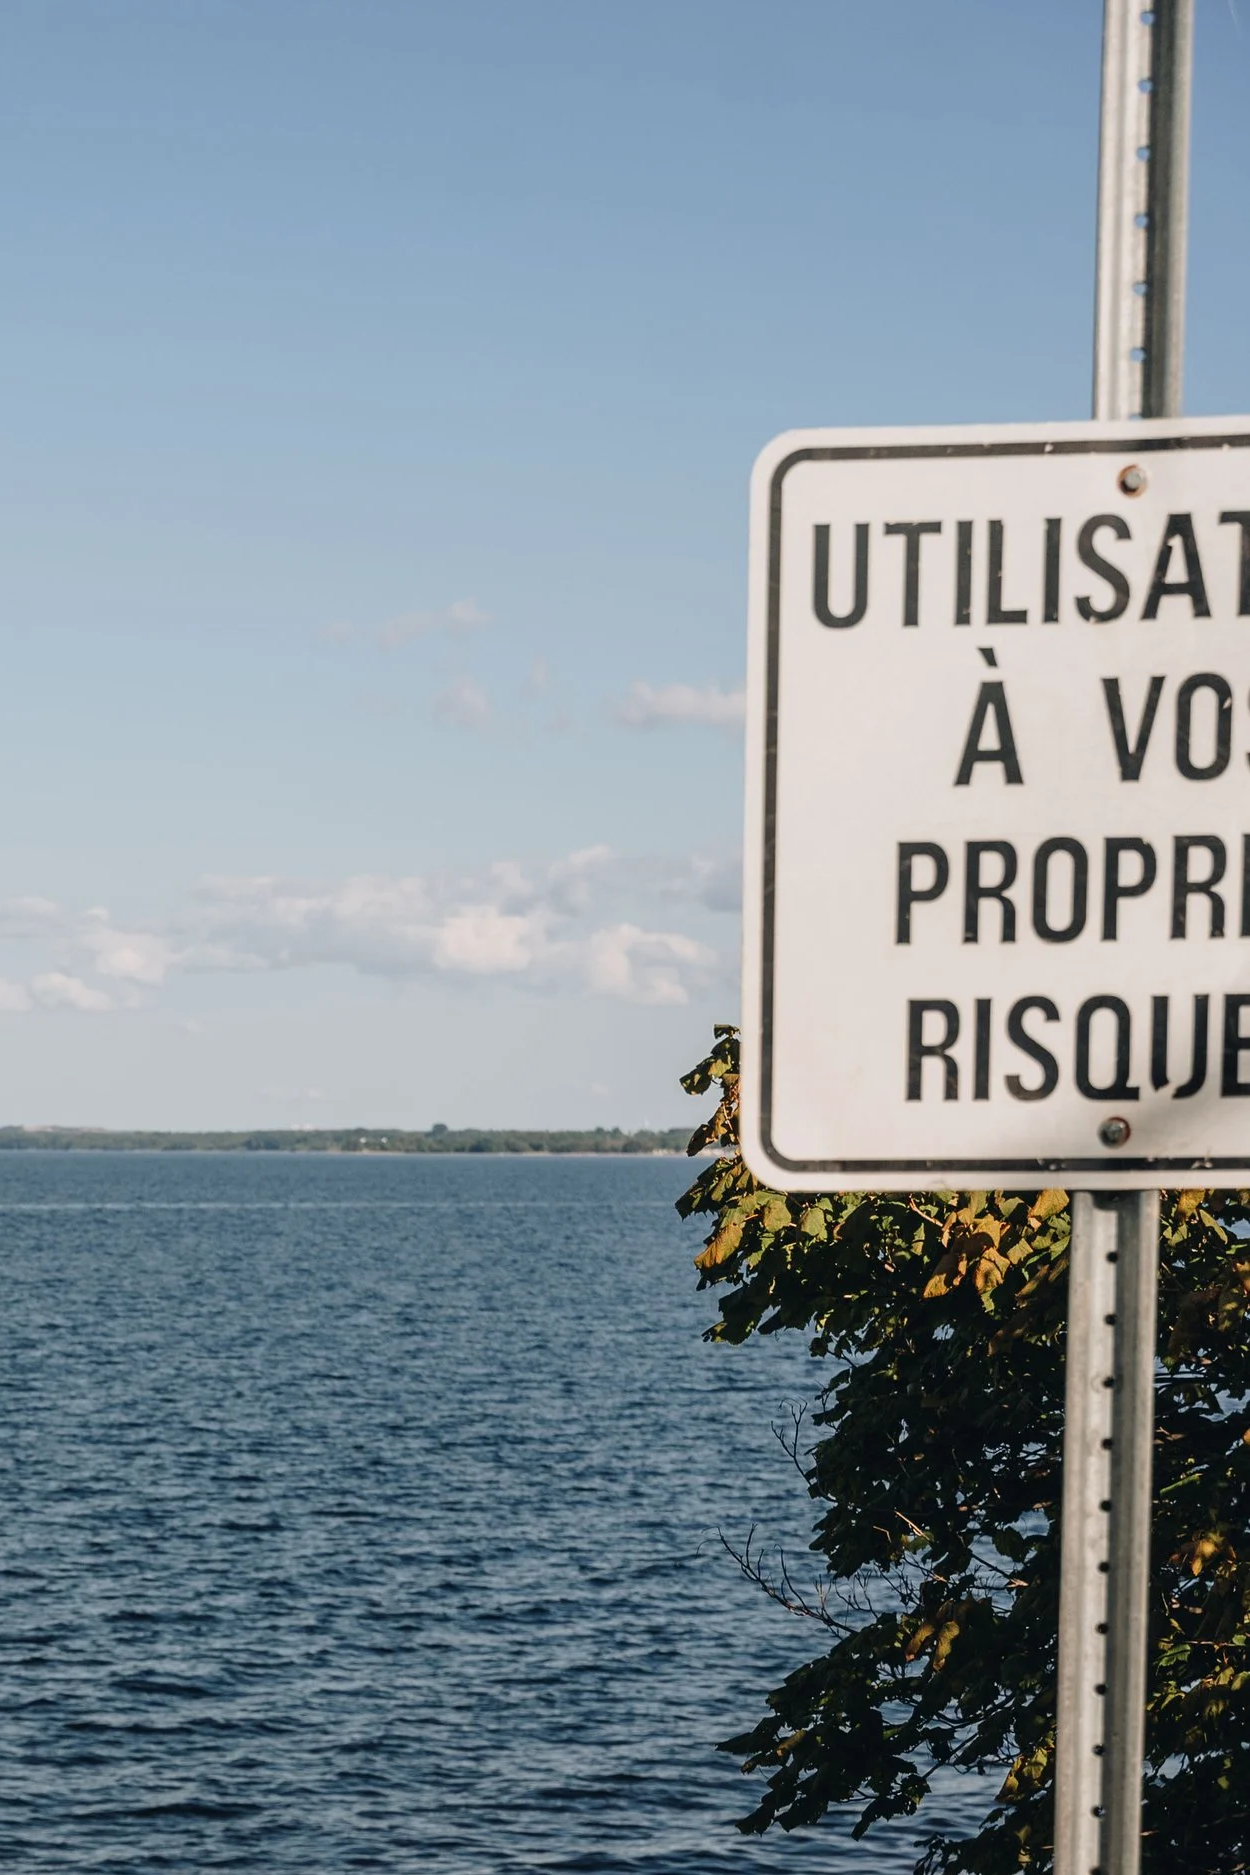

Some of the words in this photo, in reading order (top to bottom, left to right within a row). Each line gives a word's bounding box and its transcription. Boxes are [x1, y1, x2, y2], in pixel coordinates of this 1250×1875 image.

[954, 647, 1024, 786] À
[1101, 672, 1250, 782] VO
[896, 833, 1250, 945] PROPR
